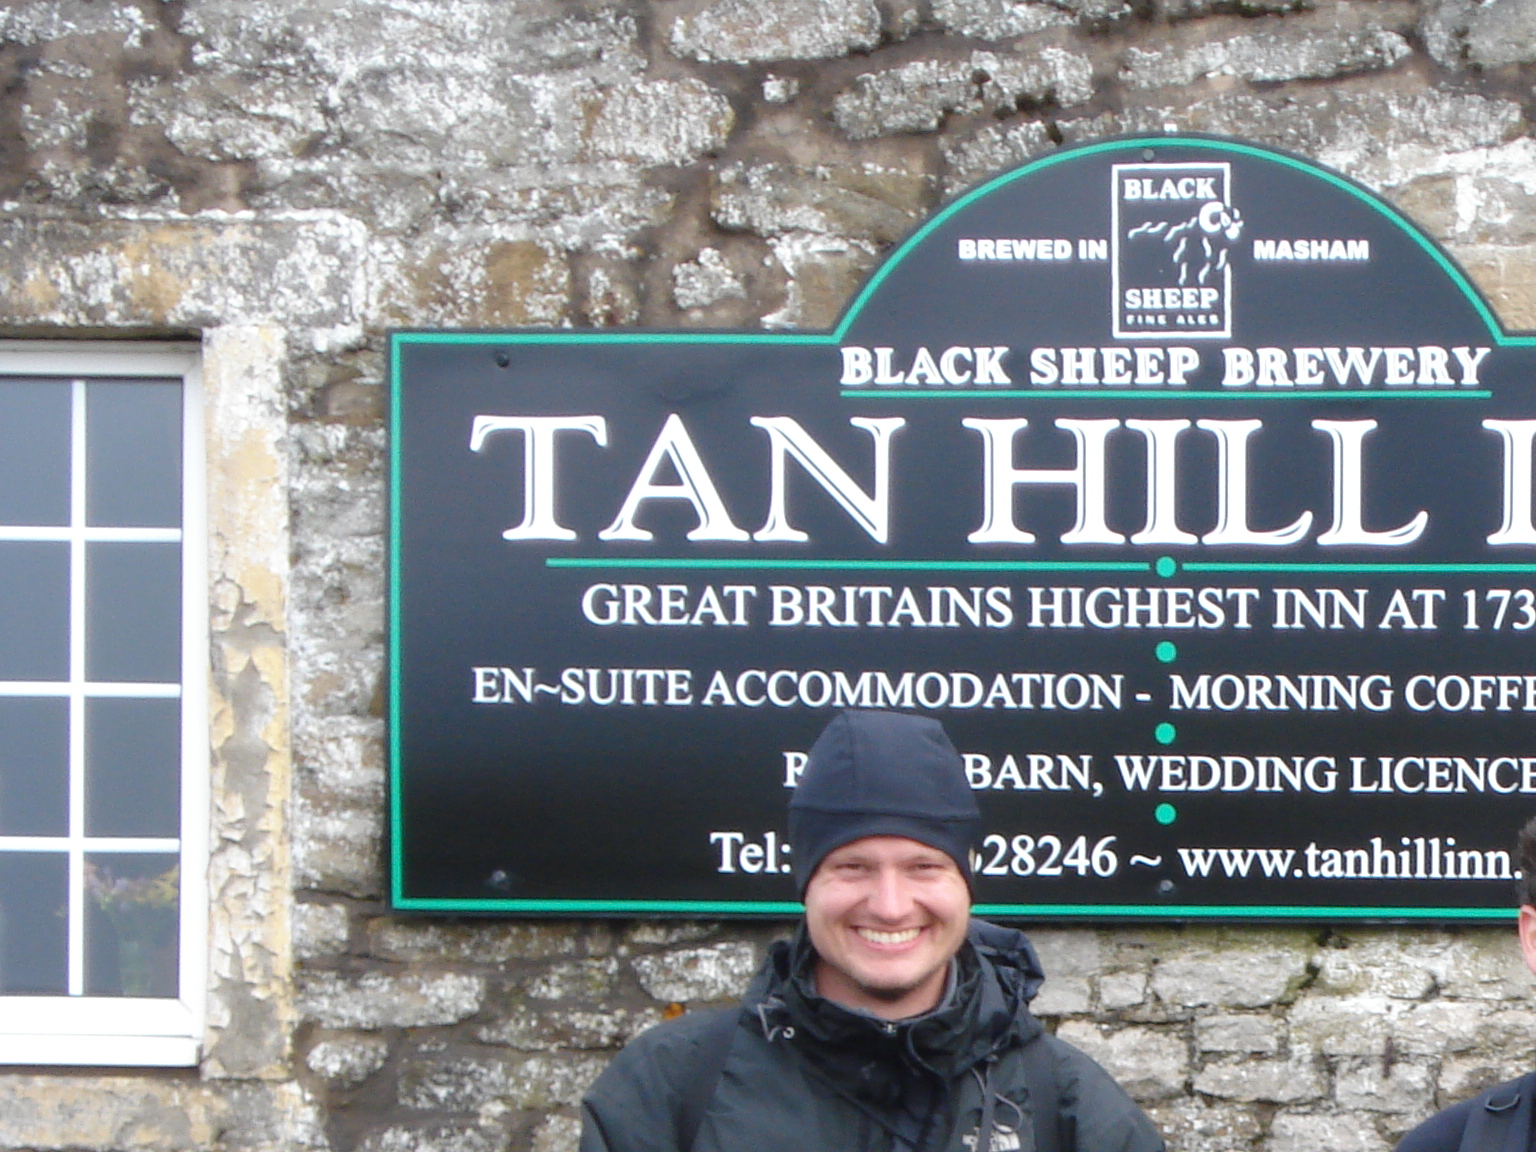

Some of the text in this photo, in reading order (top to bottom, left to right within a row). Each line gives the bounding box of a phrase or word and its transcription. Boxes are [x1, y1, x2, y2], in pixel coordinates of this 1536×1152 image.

[1123, 177, 1217, 200] BLACK
[958, 239, 1108, 263] BREWED IN
[1253, 240, 1369, 263] MASHAM
[1125, 287, 1219, 309] SHEEP
[1126, 314, 1219, 325] FINE ALES
[840, 346, 1491, 387] BLACK SHEEP BREWERY
[470, 413, 906, 544] TAN
[962, 418, 1428, 545] HILL
[582, 583, 757, 625] GREAT
[769, 586, 1013, 627] BRITAINS
[1028, 587, 1259, 628] HIGHEST
[1273, 589, 1368, 628] INN
[1379, 589, 1445, 629] AT
[702, 670, 1124, 709] ACCOMMODATION
[1170, 674, 1393, 710] MORNING
[962, 754, 1103, 796] BARN,
[1114, 756, 1338, 791] WEDDING
[710, 832, 791, 872] Tel:
